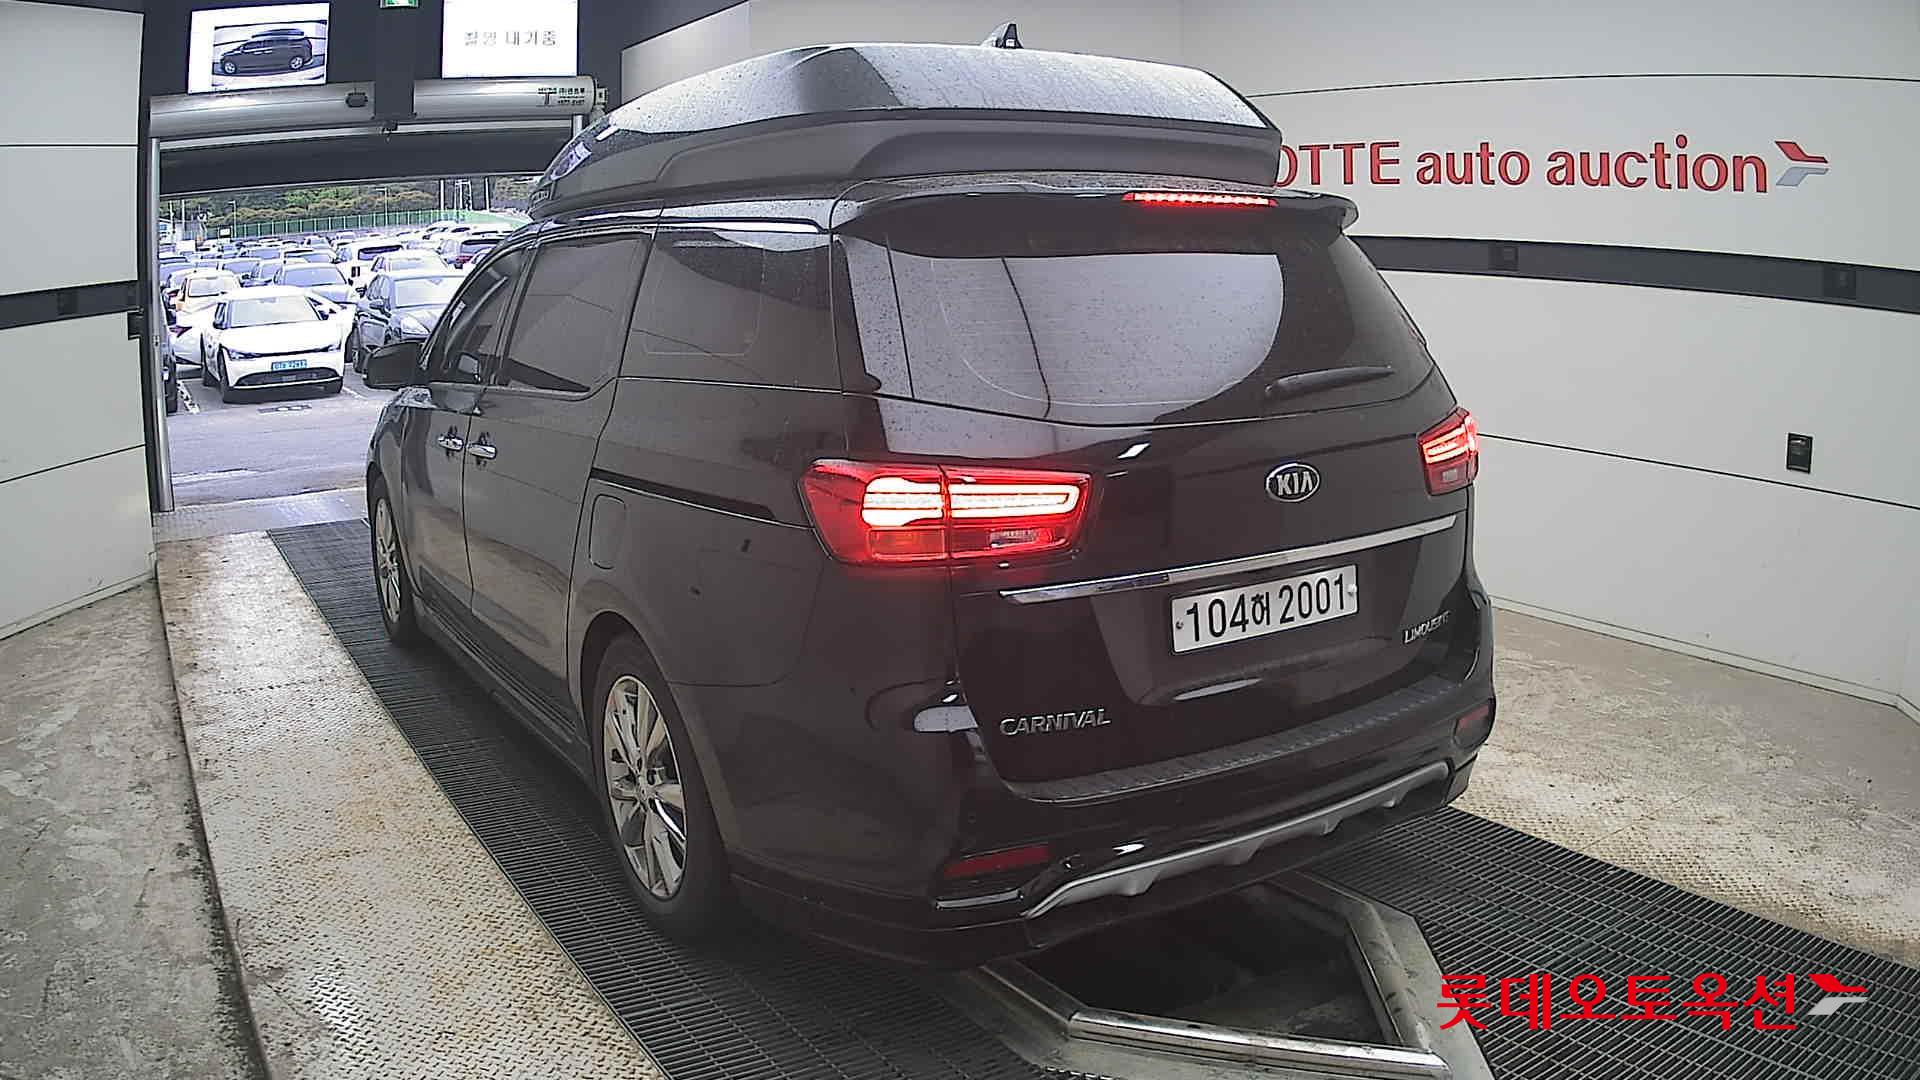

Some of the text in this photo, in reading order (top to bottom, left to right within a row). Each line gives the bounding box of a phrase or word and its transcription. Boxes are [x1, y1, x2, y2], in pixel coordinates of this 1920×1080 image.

[1276, 133, 1769, 194] OTTE auto auction
[1278, 573, 1345, 625] 2001
[999, 707, 1112, 736] CARNIVAL
